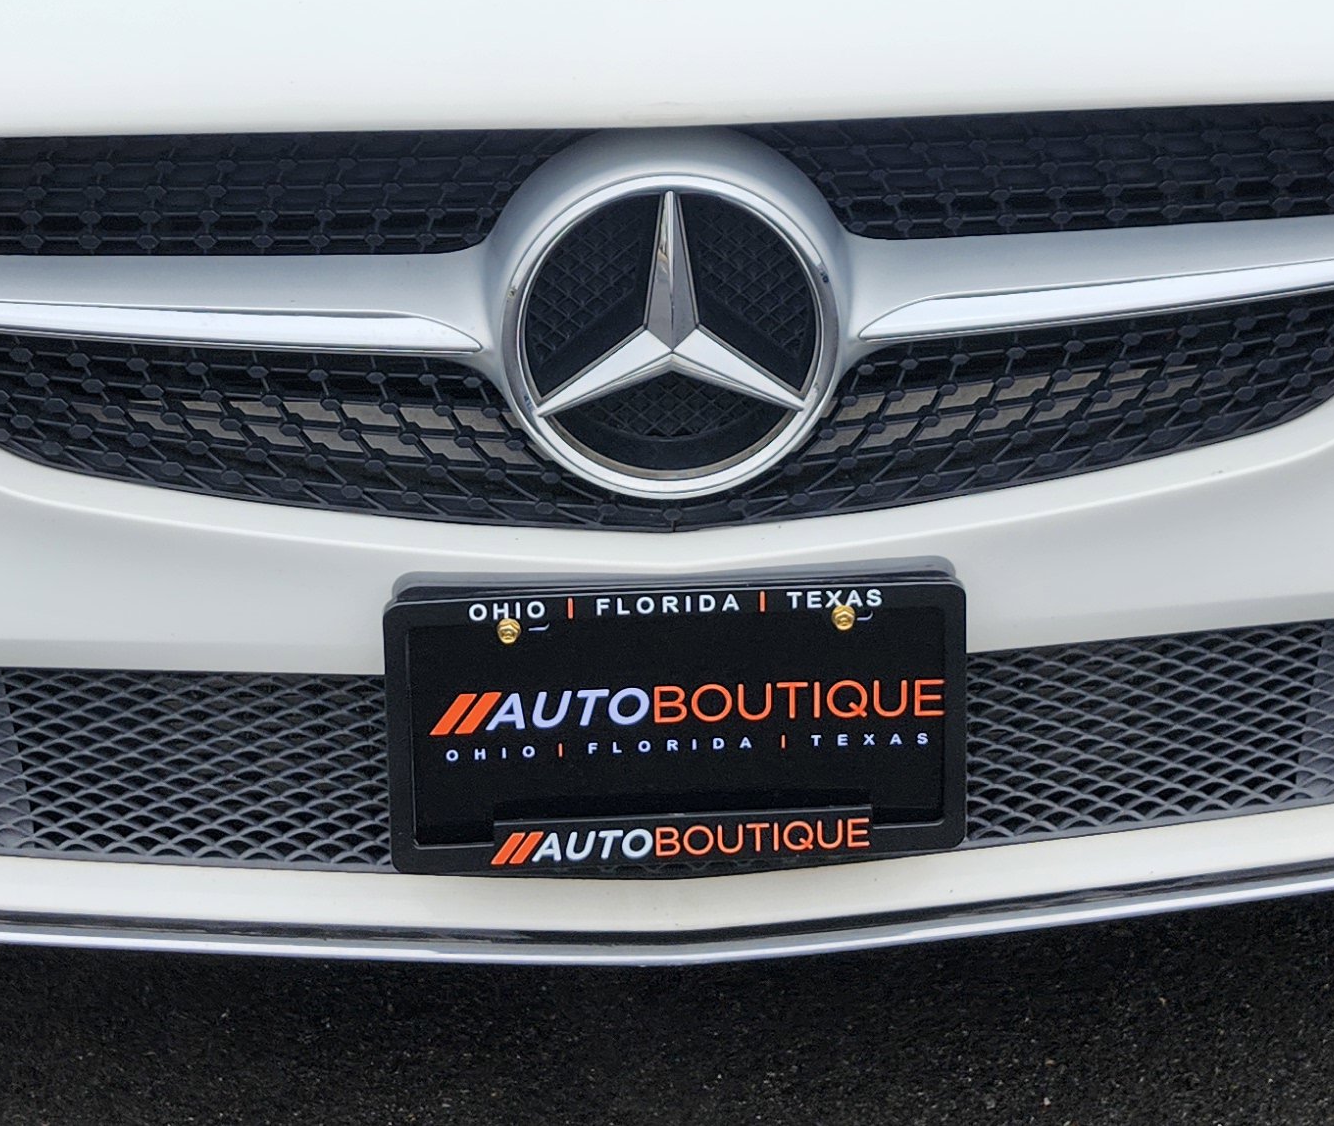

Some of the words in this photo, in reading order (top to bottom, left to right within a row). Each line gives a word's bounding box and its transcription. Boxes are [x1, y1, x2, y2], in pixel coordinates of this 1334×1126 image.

[468, 600, 546, 622] OHIO
[595, 593, 740, 617] FLORIDA
[786, 588, 883, 610] TEXAS
[484, 678, 946, 732] AUTOBOUTIQUE
[445, 744, 536, 762] OHIO
[587, 735, 753, 755] FLORIDA
[810, 731, 929, 748] TEXAS
[531, 817, 871, 863] AUTOBOUTIQUE
